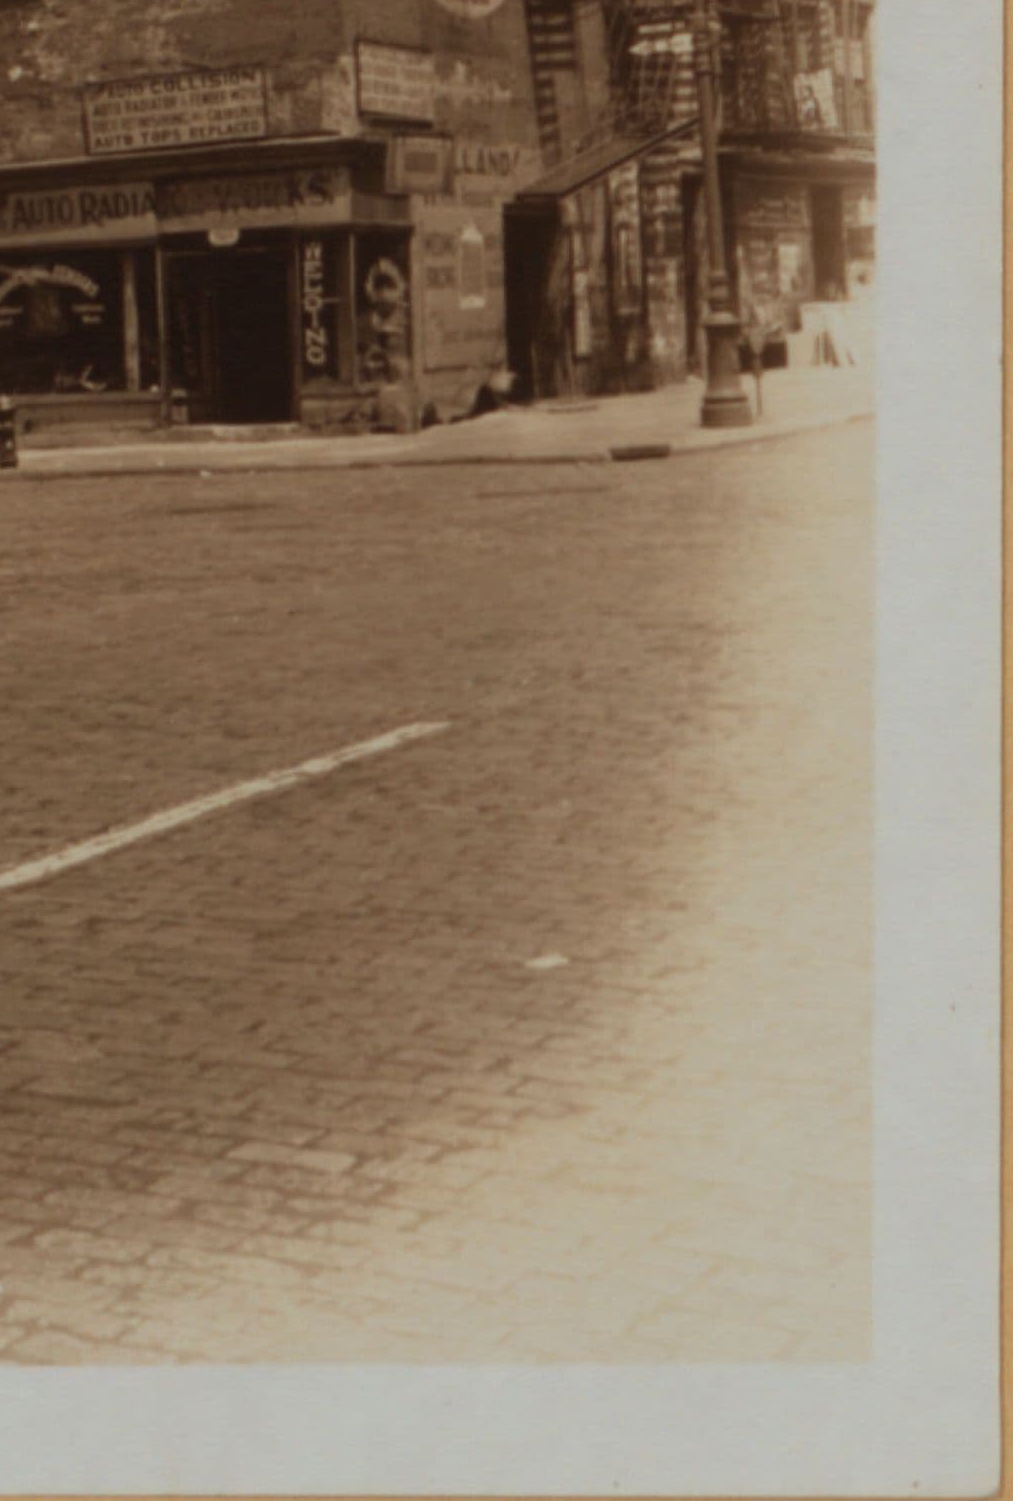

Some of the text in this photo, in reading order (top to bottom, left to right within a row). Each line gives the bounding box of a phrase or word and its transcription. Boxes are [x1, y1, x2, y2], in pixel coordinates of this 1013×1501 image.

[150, 71, 256, 94] COLLISION
[140, 129, 182, 145] TOPS
[10, 193, 74, 230] AUTO
